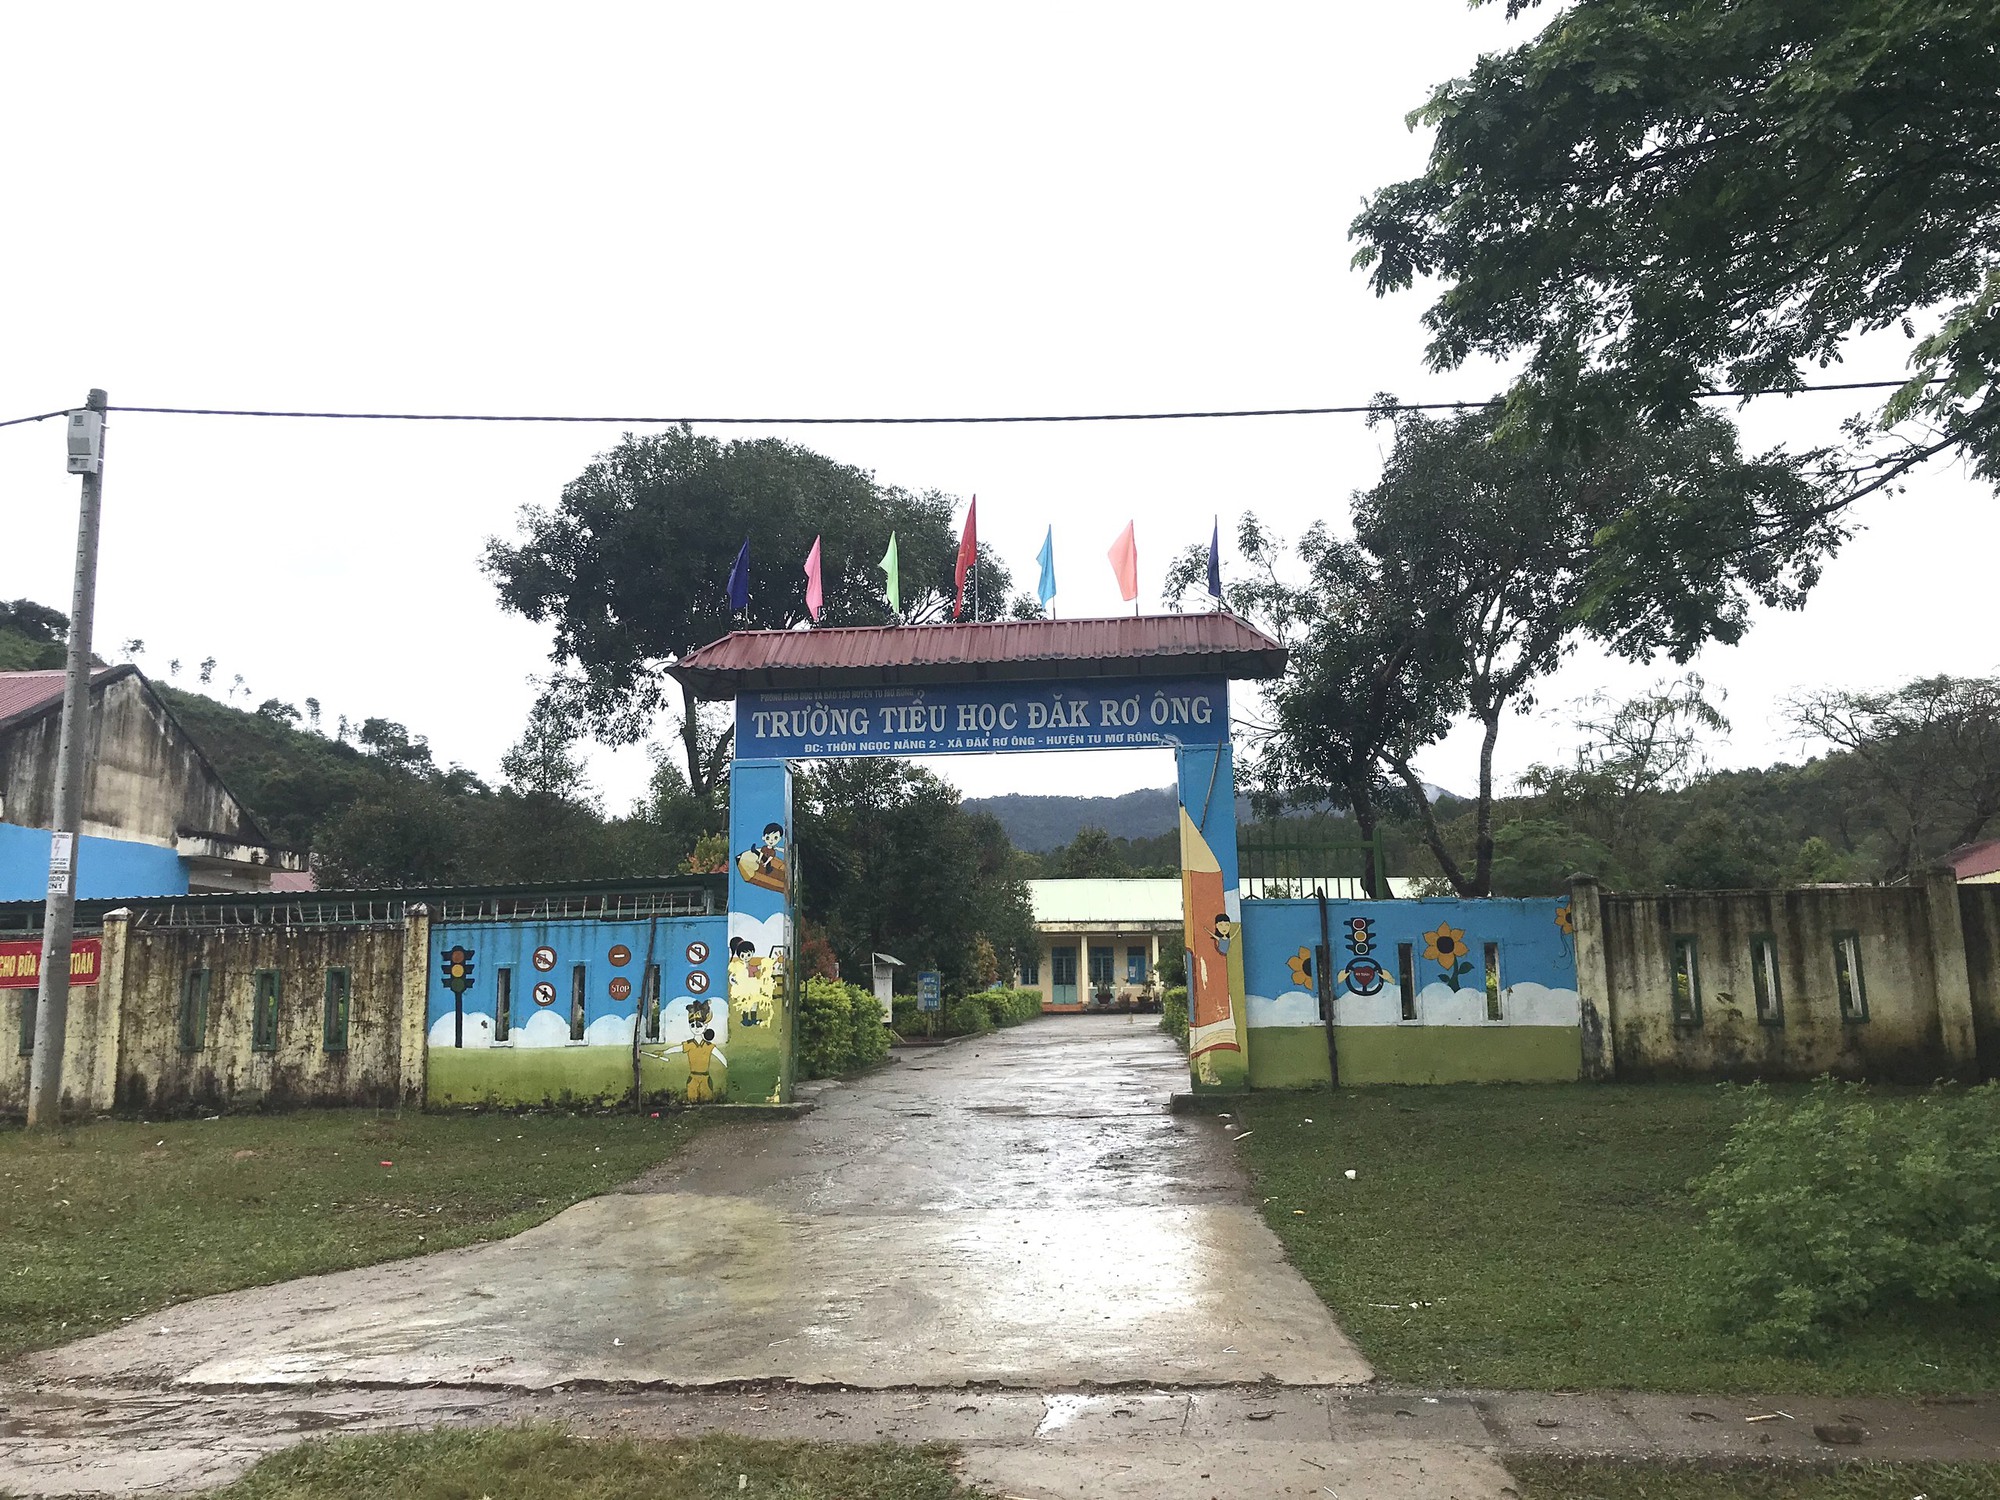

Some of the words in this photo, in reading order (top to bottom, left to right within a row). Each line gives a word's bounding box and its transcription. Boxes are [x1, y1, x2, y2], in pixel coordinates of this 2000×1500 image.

[752, 702, 869, 738] TRƯỜNG
[879, 690, 947, 734] TIỂU
[957, 702, 1018, 737] HỌC
[1027, 693, 1090, 729] ĐĂK
[1100, 694, 1140, 727] RƠ
[1151, 690, 1213, 725] ÔNG
[804, 744, 823, 753] ĐC:
[827, 740, 856, 752] THÔN
[859, 741, 891, 753] NGỌC
[929, 739, 936, 749] 2
[947, 737, 963, 748] XÃ
[966, 737, 989, 748] ĐĂK
[992, 736, 1008, 747] RƠ
[1011, 736, 1035, 746] ÔNG
[1046, 733, 1084, 746] HUYỆN
[1087, 733, 1102, 744] TU
[1105, 732, 1124, 743] MƠ
[1127, 732, 1159, 743] RÔNG
[611, 985, 630, 993] STOP
